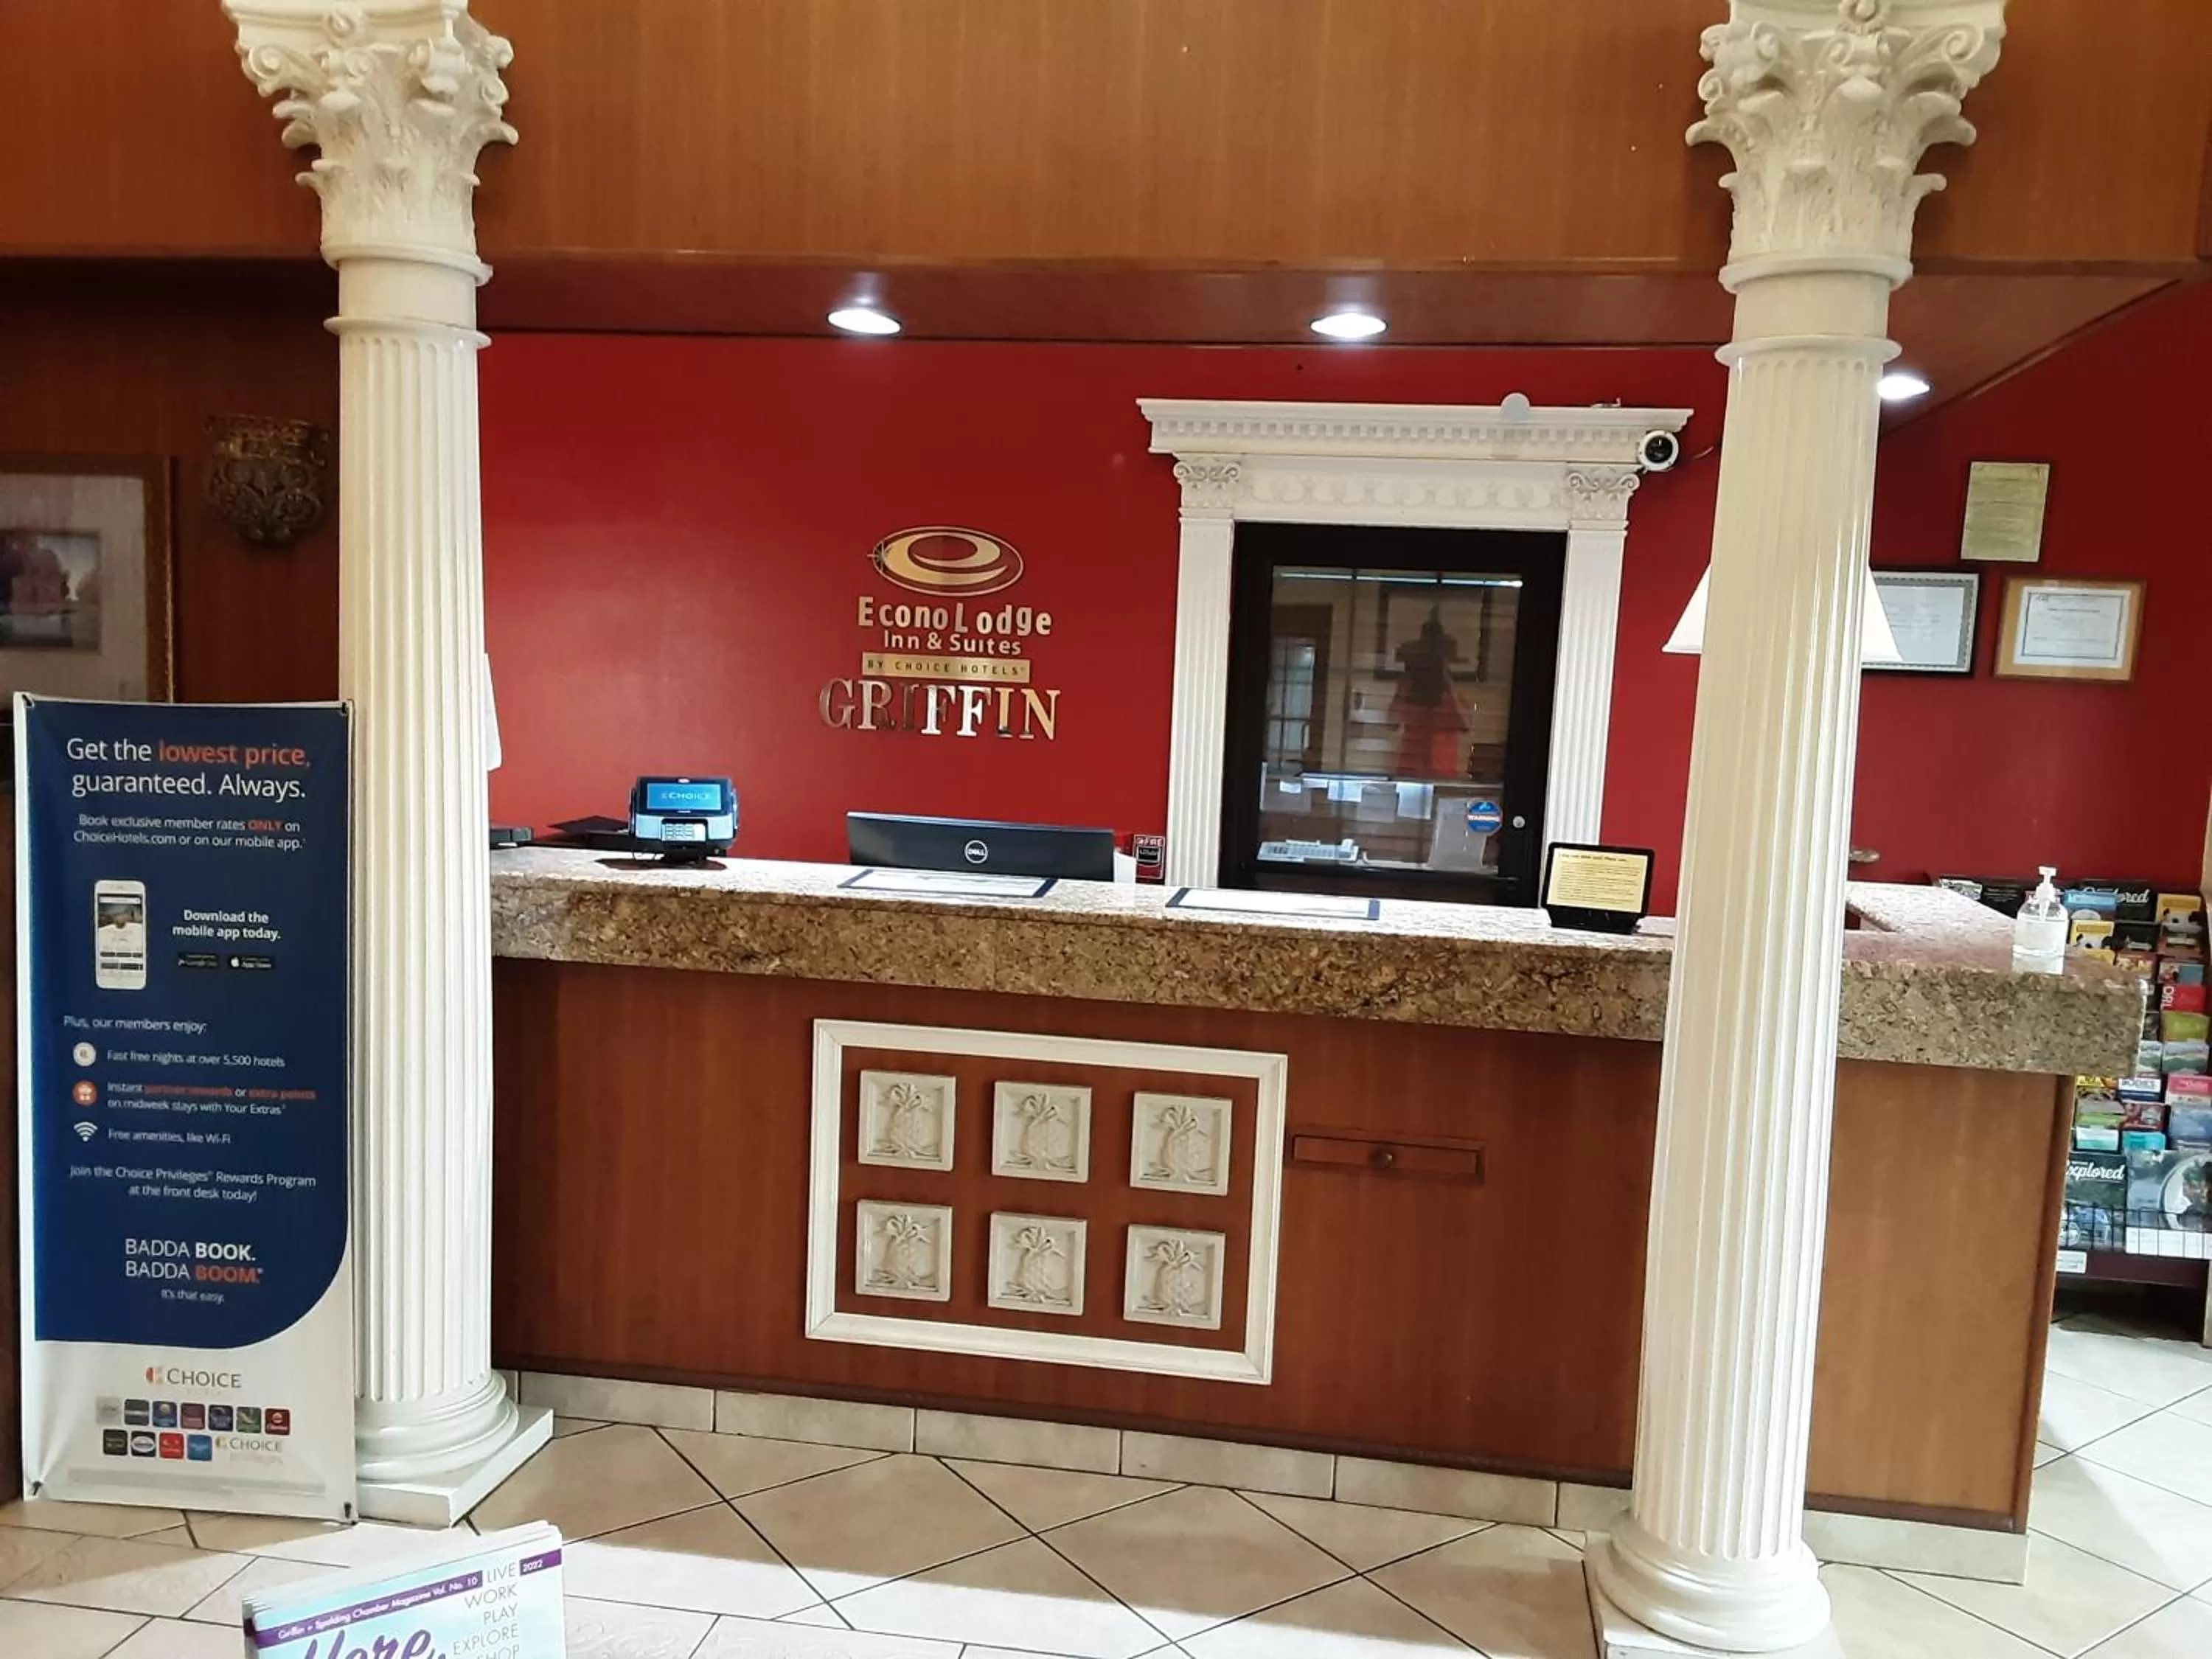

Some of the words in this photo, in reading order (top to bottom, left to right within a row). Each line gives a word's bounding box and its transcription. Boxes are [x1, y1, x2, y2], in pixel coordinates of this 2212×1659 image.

[858, 596, 949, 629] Econo
[955, 603, 1053, 636] Lodge
[884, 629, 920, 650] Inn
[927, 634, 942, 650] &
[950, 634, 1022, 655] Suites
[867, 660, 883, 669] BY
[894, 661, 950, 673] CHOICE
[818, 677, 1062, 741] GRIFFIN
[66, 737, 108, 762] Get
[114, 738, 153, 762] the
[158, 740, 239, 765] lowest
[71, 771, 212, 799] guaranteed.
[218, 773, 307, 803] Always.
[78, 813, 108, 827] Book
[111, 815, 161, 829] exclusive
[164, 815, 214, 830] member
[216, 818, 246, 831] rates
[284, 822, 301, 832] on
[72, 830, 176, 846] ChoiceHotels.com
[179, 835, 192, 846] or
[194, 835, 209, 846] on
[212, 836, 232, 847] our
[234, 835, 275, 849] mobile
[183, 909, 246, 923] Download
[248, 911, 270, 925] the
[172, 925, 215, 937] mobile
[216, 928, 240, 942] app
[242, 927, 282, 942] today.
[91, 1018, 113, 1029] our
[114, 1018, 171, 1032] members
[106, 1049, 128, 1062] Fast
[129, 1050, 150, 1062] free
[152, 1052, 184, 1066] nights
[185, 1054, 197, 1064] at
[198, 1054, 220, 1065] over
[253, 1056, 285, 1068] hotels
[106, 1082, 143, 1093] Instant
[234, 1088, 247, 1098] or
[171, 1101, 198, 1115] stays
[199, 1102, 222, 1113] with
[224, 1104, 246, 1115] Your
[108, 1128, 131, 1141] Free
[186, 1132, 204, 1144] like
[69, 1165, 93, 1178] Join
[94, 1166, 112, 1178] the
[115, 1166, 153, 1180] Choice
[215, 1170, 265, 1185] Rewards
[266, 1173, 317, 1189] Program
[128, 1186, 139, 1197] at
[142, 1184, 161, 1197] the
[163, 1186, 192, 1199] front
[193, 1187, 220, 1199] desk
[124, 1237, 191, 1258] BADDA
[195, 1242, 257, 1262] BOOK.
[125, 1260, 192, 1280] BADDA
[166, 1366, 243, 1389] CHOICE
[229, 1437, 285, 1453] CHOICE
[486, 1561, 517, 1585] LIVE
[521, 1558, 544, 1573] 2022
[448, 1582, 464, 1593] No.
[467, 1575, 479, 1587] 10
[464, 1583, 518, 1609] WORK
[483, 1603, 518, 1626] PLAY
[453, 1623, 521, 1656] EXPLORE
